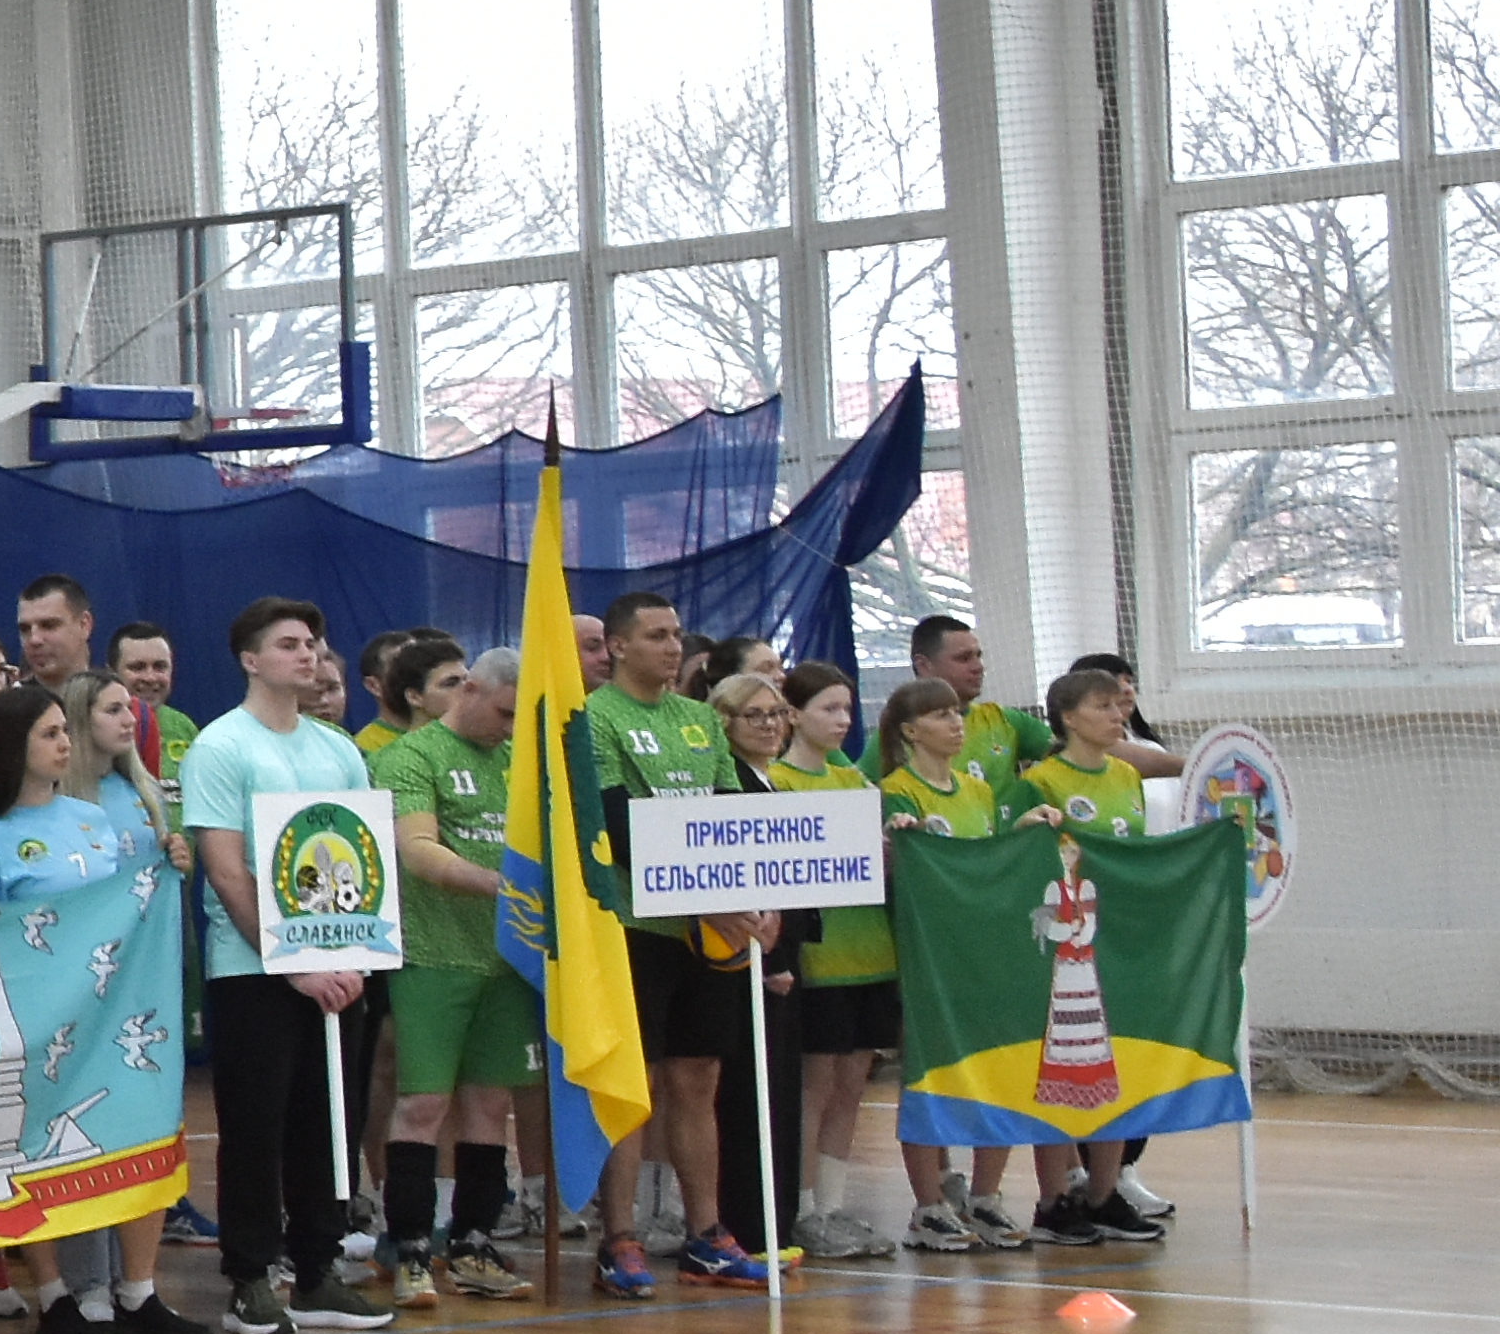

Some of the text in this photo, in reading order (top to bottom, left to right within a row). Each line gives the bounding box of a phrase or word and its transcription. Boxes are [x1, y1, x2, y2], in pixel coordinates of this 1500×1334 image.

[627, 730, 660, 754] 13
[449, 769, 478, 796] 11
[306, 806, 337, 826] ФСК
[685, 815, 826, 848] ПРИБРЕЖНОЕ
[67, 852, 89, 879] 7
[643, 855, 872, 894] СЕЛЬСКОЕ ПОСЕЛЕНИЕ
[285, 923, 377, 945] СЛАВЯНСК
